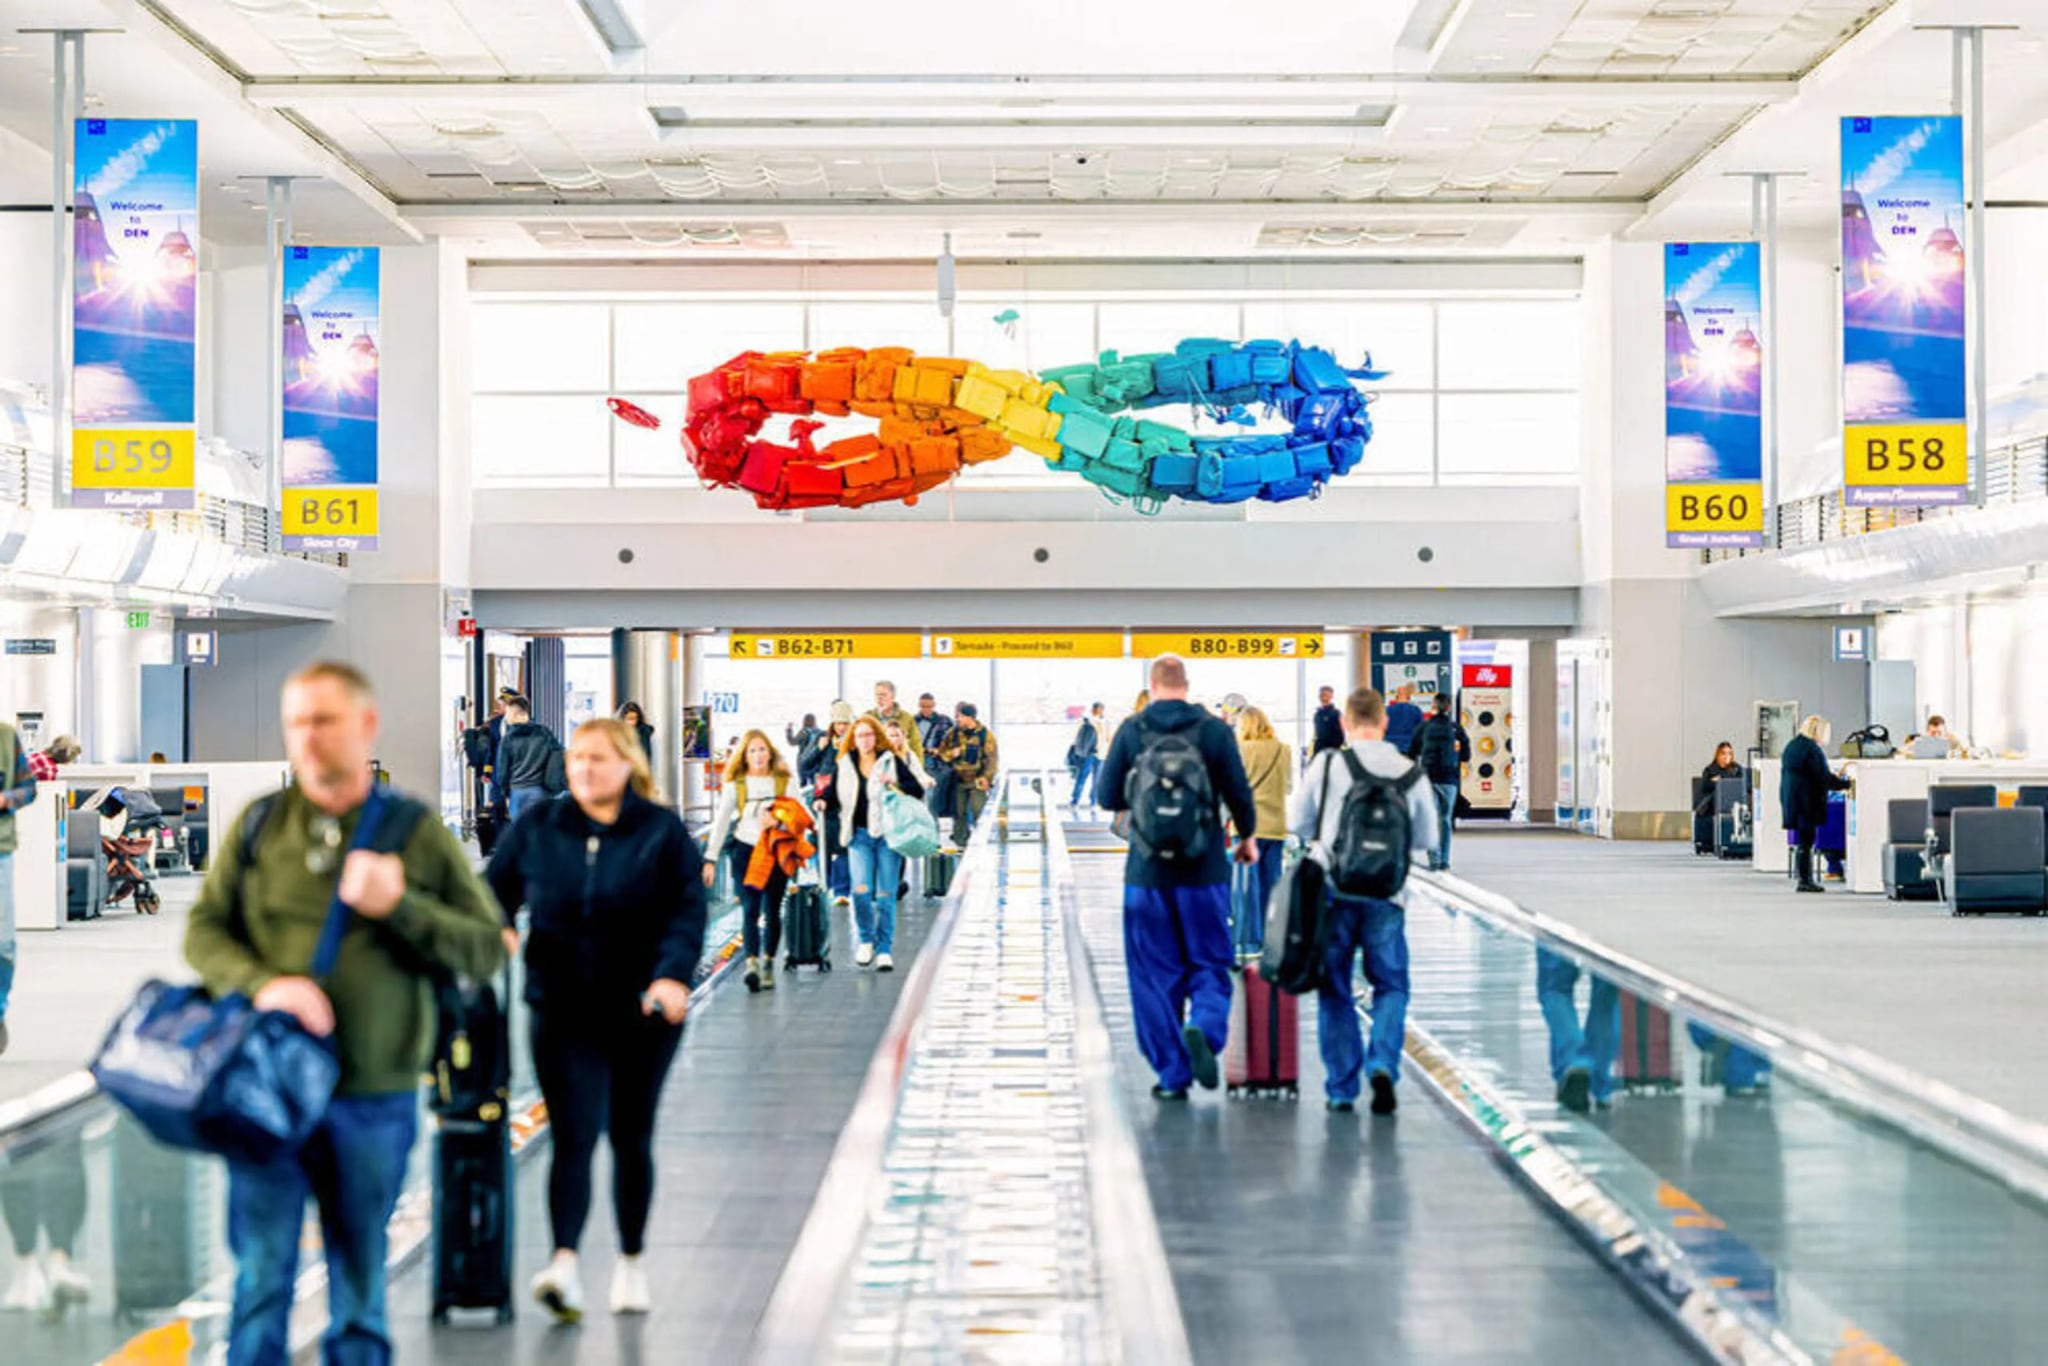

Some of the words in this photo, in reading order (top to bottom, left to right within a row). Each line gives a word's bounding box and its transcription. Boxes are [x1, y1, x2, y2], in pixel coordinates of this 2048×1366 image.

[110, 201, 163, 211] Welcome
[1877, 199, 1930, 208] Welcome
[129, 216, 141, 224] to
[1896, 213, 1909, 222] to
[124, 228, 149, 238] DEN
[1891, 225, 1916, 235] DEN
[311, 311, 353, 319] Welcome
[93, 439, 173, 474] B59
[1867, 438, 1945, 471] B58
[301, 498, 359, 526] B61
[1681, 494, 1748, 522] B60
[127, 611, 150, 629] EXIT
[778, 638, 854, 656] B62-B71
[1190, 638, 1275, 655] B80-B99
